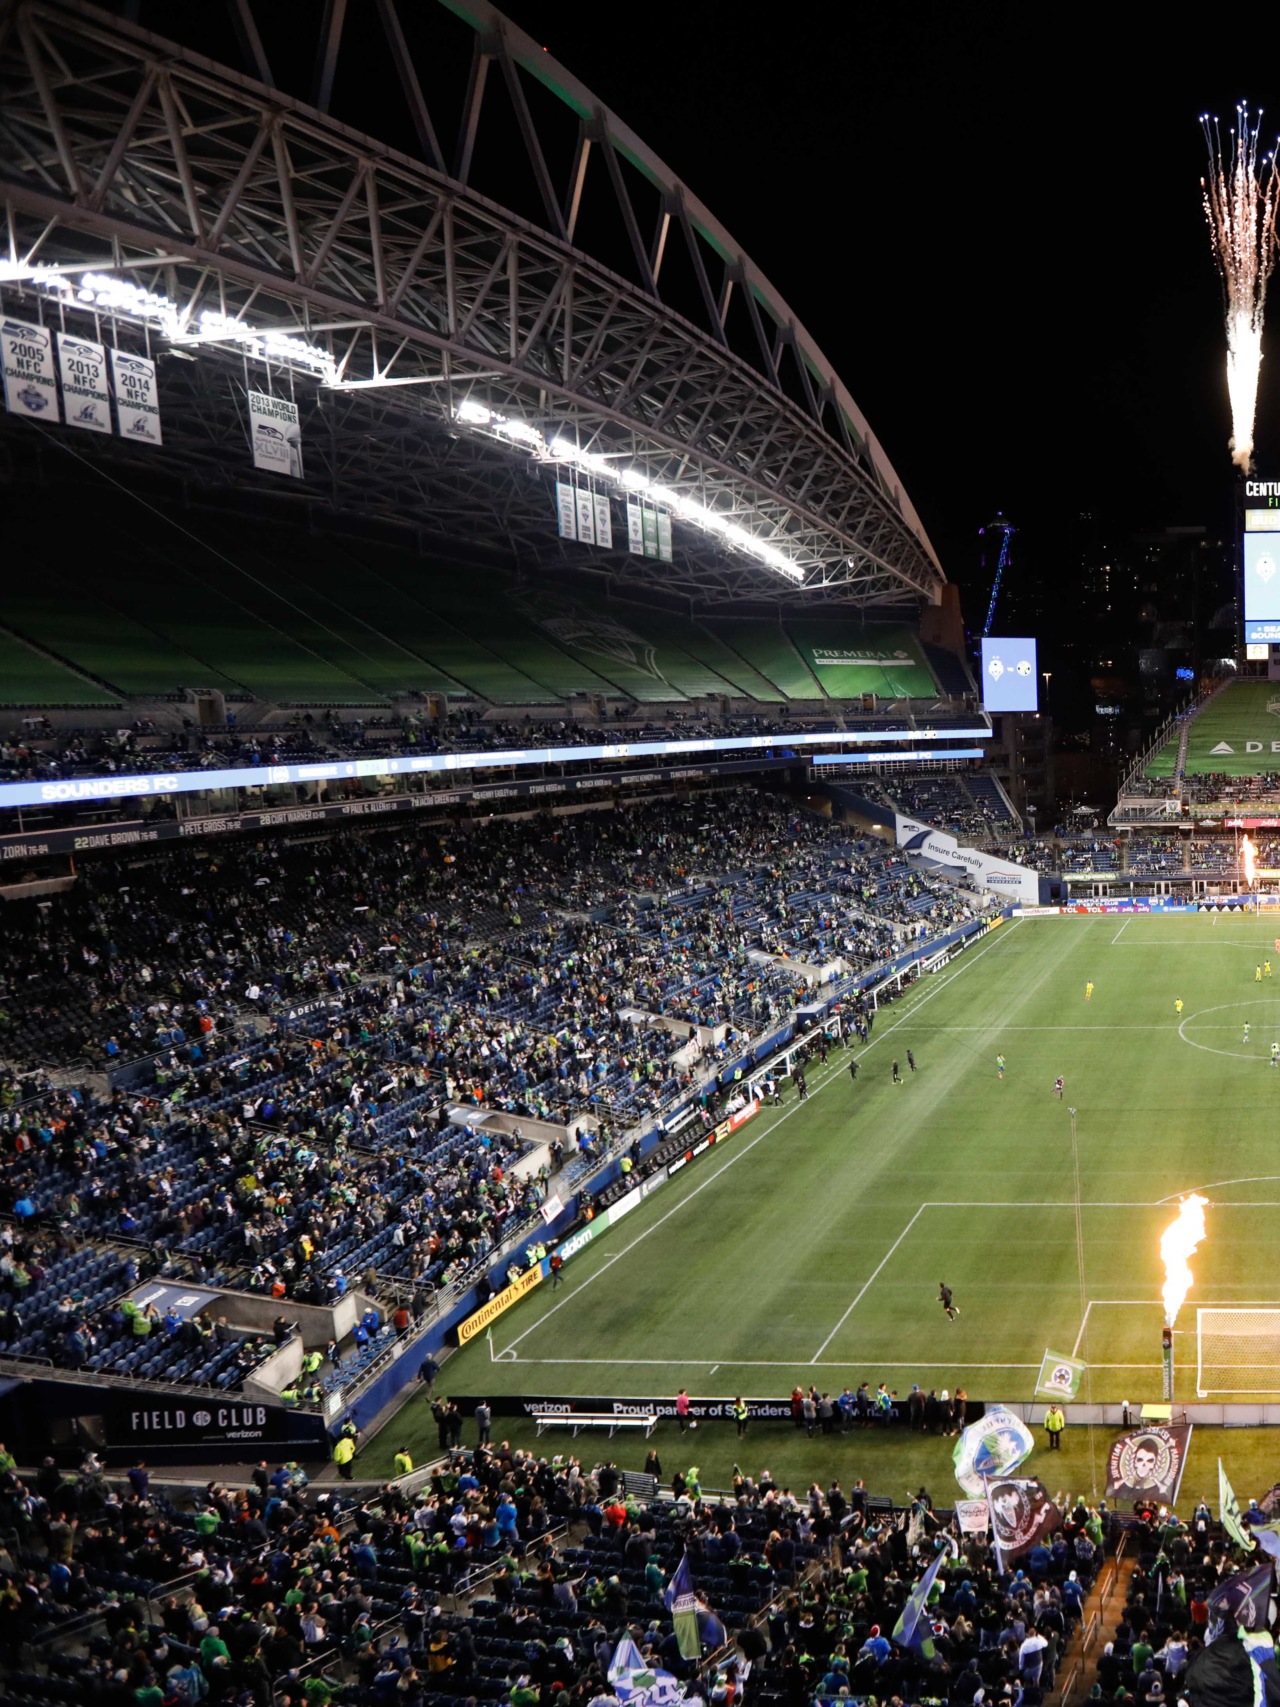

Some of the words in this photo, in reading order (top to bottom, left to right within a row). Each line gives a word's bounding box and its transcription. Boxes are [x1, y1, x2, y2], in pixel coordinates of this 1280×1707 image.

[9, 341, 45, 362] 2005
[16, 357, 41, 374] NFC
[67, 358, 99, 378] 2013
[5, 367, 55, 388] CHAMPIONS
[73, 373, 96, 389] NFC
[121, 373, 150, 392] 2014
[63, 383, 109, 402] CHAMPIONS
[126, 388, 147, 403] NFC
[117, 397, 159, 415] CHAMPIONS
[250, 393, 270, 407] 2013
[271, 400, 296, 415] WORLD
[251, 403, 297, 424] CHAMPIONS
[254, 441, 289, 459] XLVIII
[811, 648, 886, 660] PREMERA
[41, 778, 149, 800] SOUNDERS
[153, 776, 178, 791] FC
[260, 815, 271, 826] 28
[271, 813, 286, 825] CURT
[286, 810, 312, 822] WARNER
[350, 804, 364, 815] PAUL
[370, 802, 386, 813] ALLEN
[184, 822, 202, 835] PETE
[203, 820, 226, 833] GROSS
[74, 836, 89, 849] 22
[89, 833, 110, 847] DAVE
[111, 830, 140, 845] BROWN
[3, 844, 28, 859] ZORN
[927, 842, 950, 857] Insure
[951, 851, 983, 869] Carefully
[560, 1228, 593, 1261] slalom
[461, 1289, 513, 1340] Continental
[520, 1270, 540, 1291] TIRE
[523, 1401, 571, 1413] verizon
[612, 1402, 654, 1415] Proud
[713, 1403, 723, 1415] of
[132, 1410, 186, 1430] FIELD
[218, 1407, 267, 1427] CLUB
[225, 1430, 262, 1439] verizon
